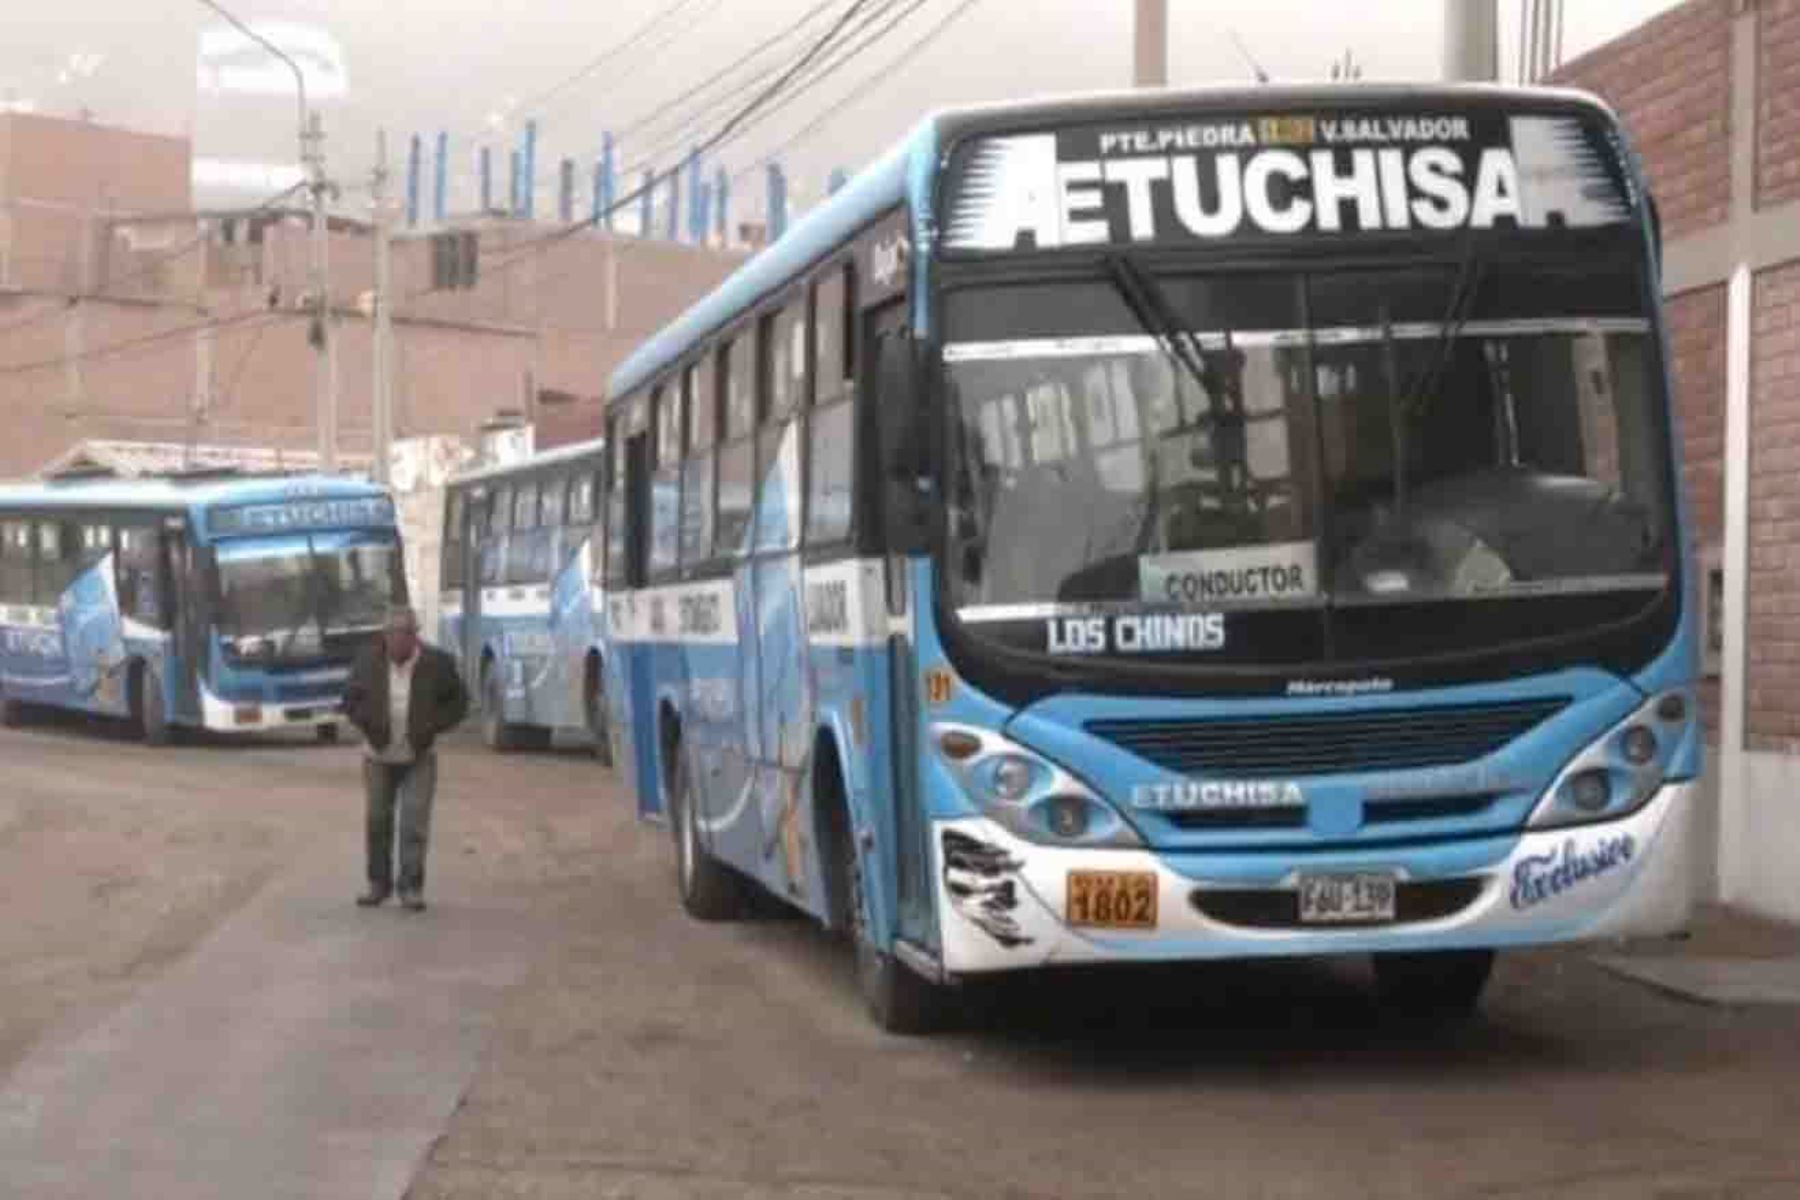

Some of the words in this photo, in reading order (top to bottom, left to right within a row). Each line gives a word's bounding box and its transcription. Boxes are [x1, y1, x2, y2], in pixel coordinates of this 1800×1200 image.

[1166, 563, 1303, 601] CONDUCTOR
[1047, 616, 1106, 655] LOS
[1115, 610, 1226, 652] CHINOS
[1131, 779, 1305, 811] ETUCHISA
